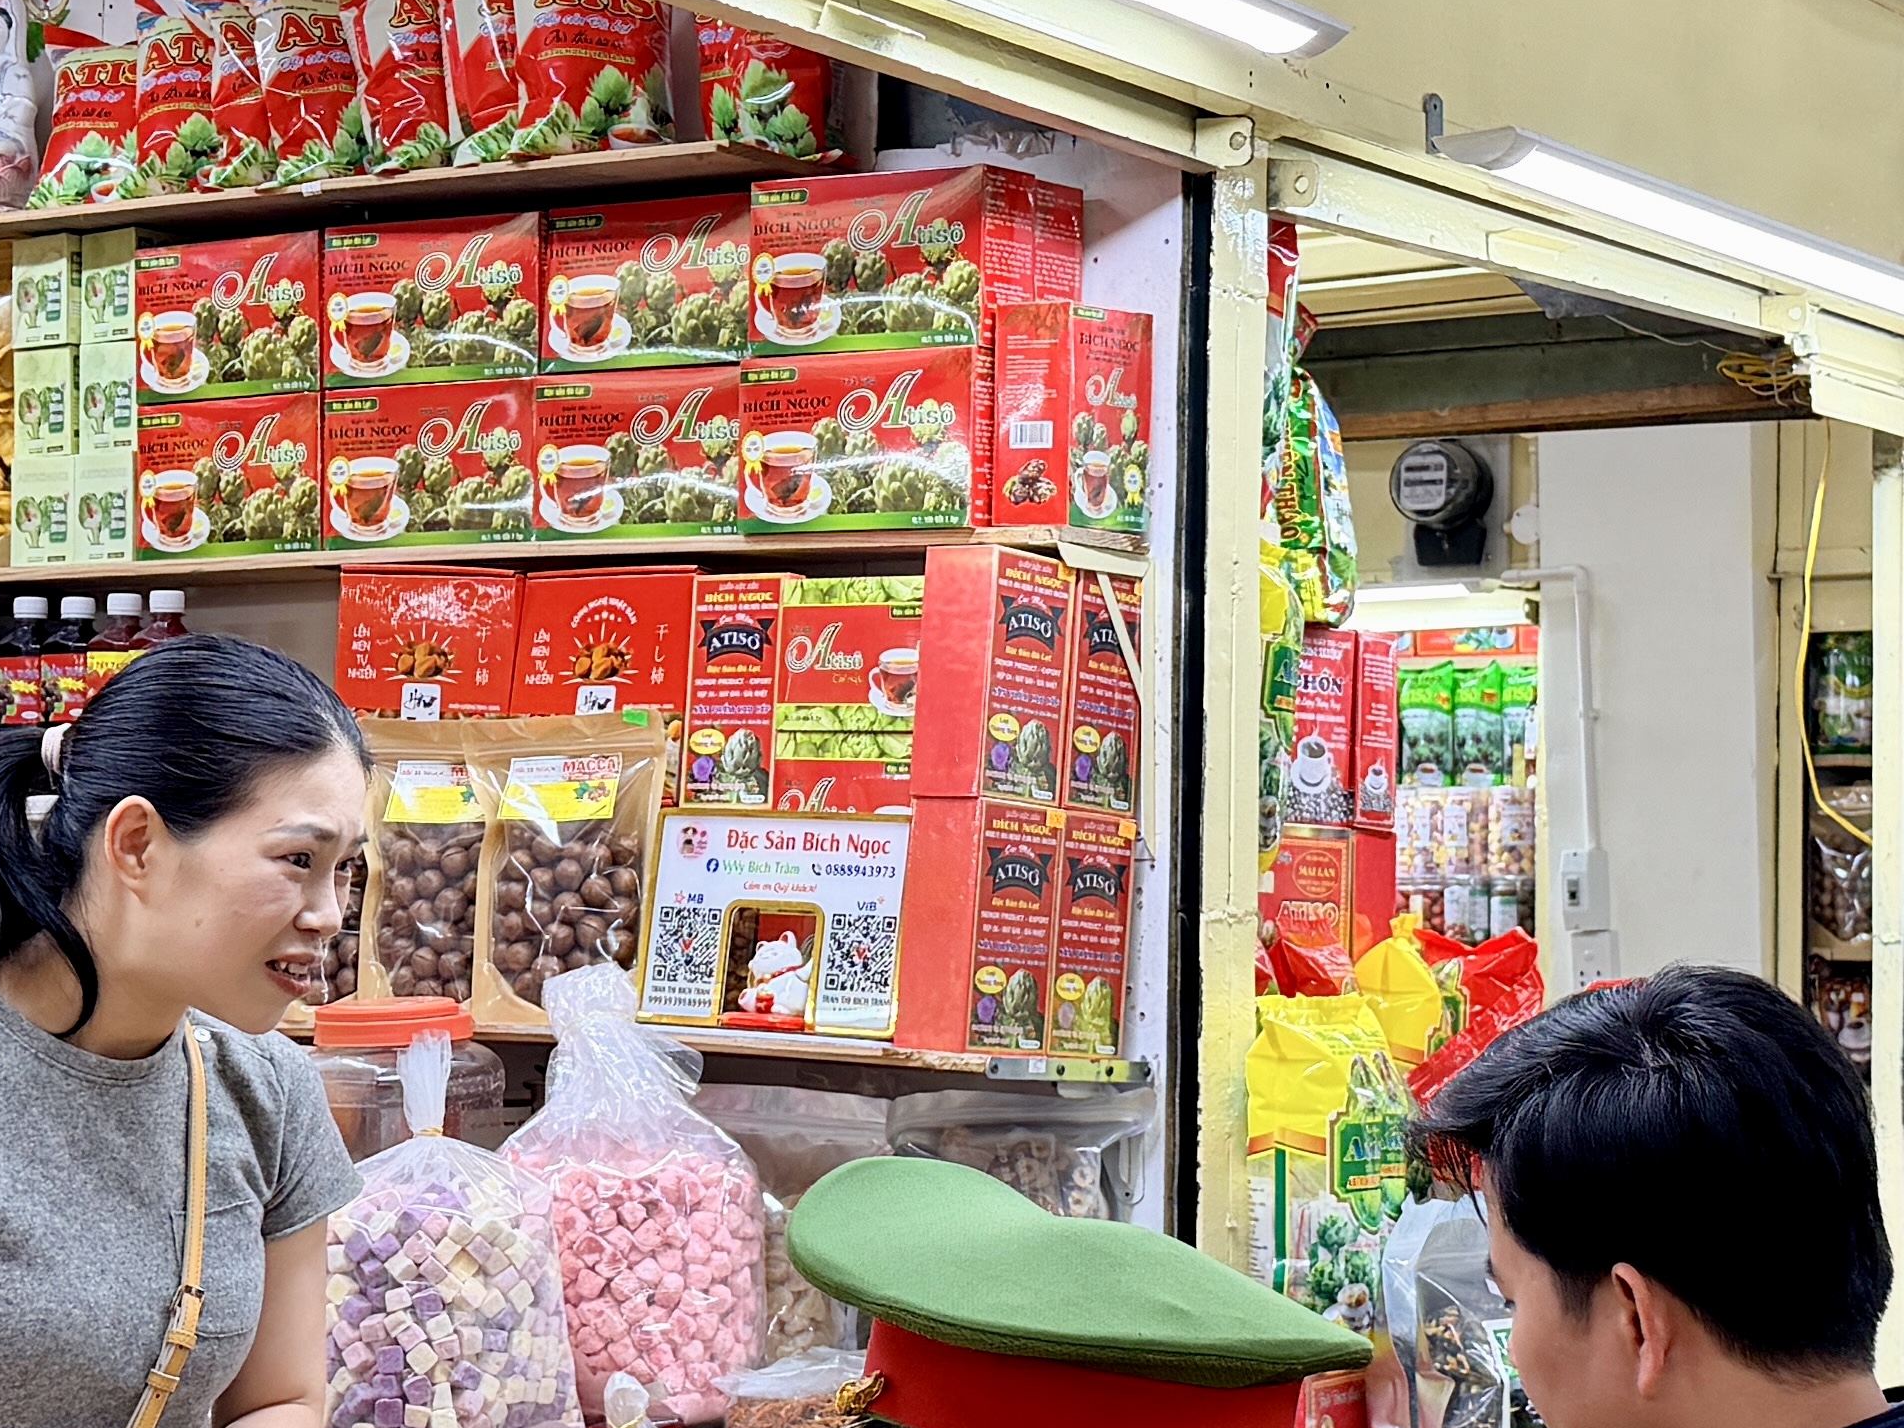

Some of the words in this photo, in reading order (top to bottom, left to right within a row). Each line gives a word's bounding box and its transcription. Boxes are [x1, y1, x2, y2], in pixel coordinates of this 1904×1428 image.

[562, 756, 618, 773] MACCA
[727, 830, 757, 854] Đặc
[764, 830, 795, 850] Sản
[803, 831, 840, 853] Bích
[847, 834, 891, 859] Ngọc
[825, 864, 896, 878] 0888943973
